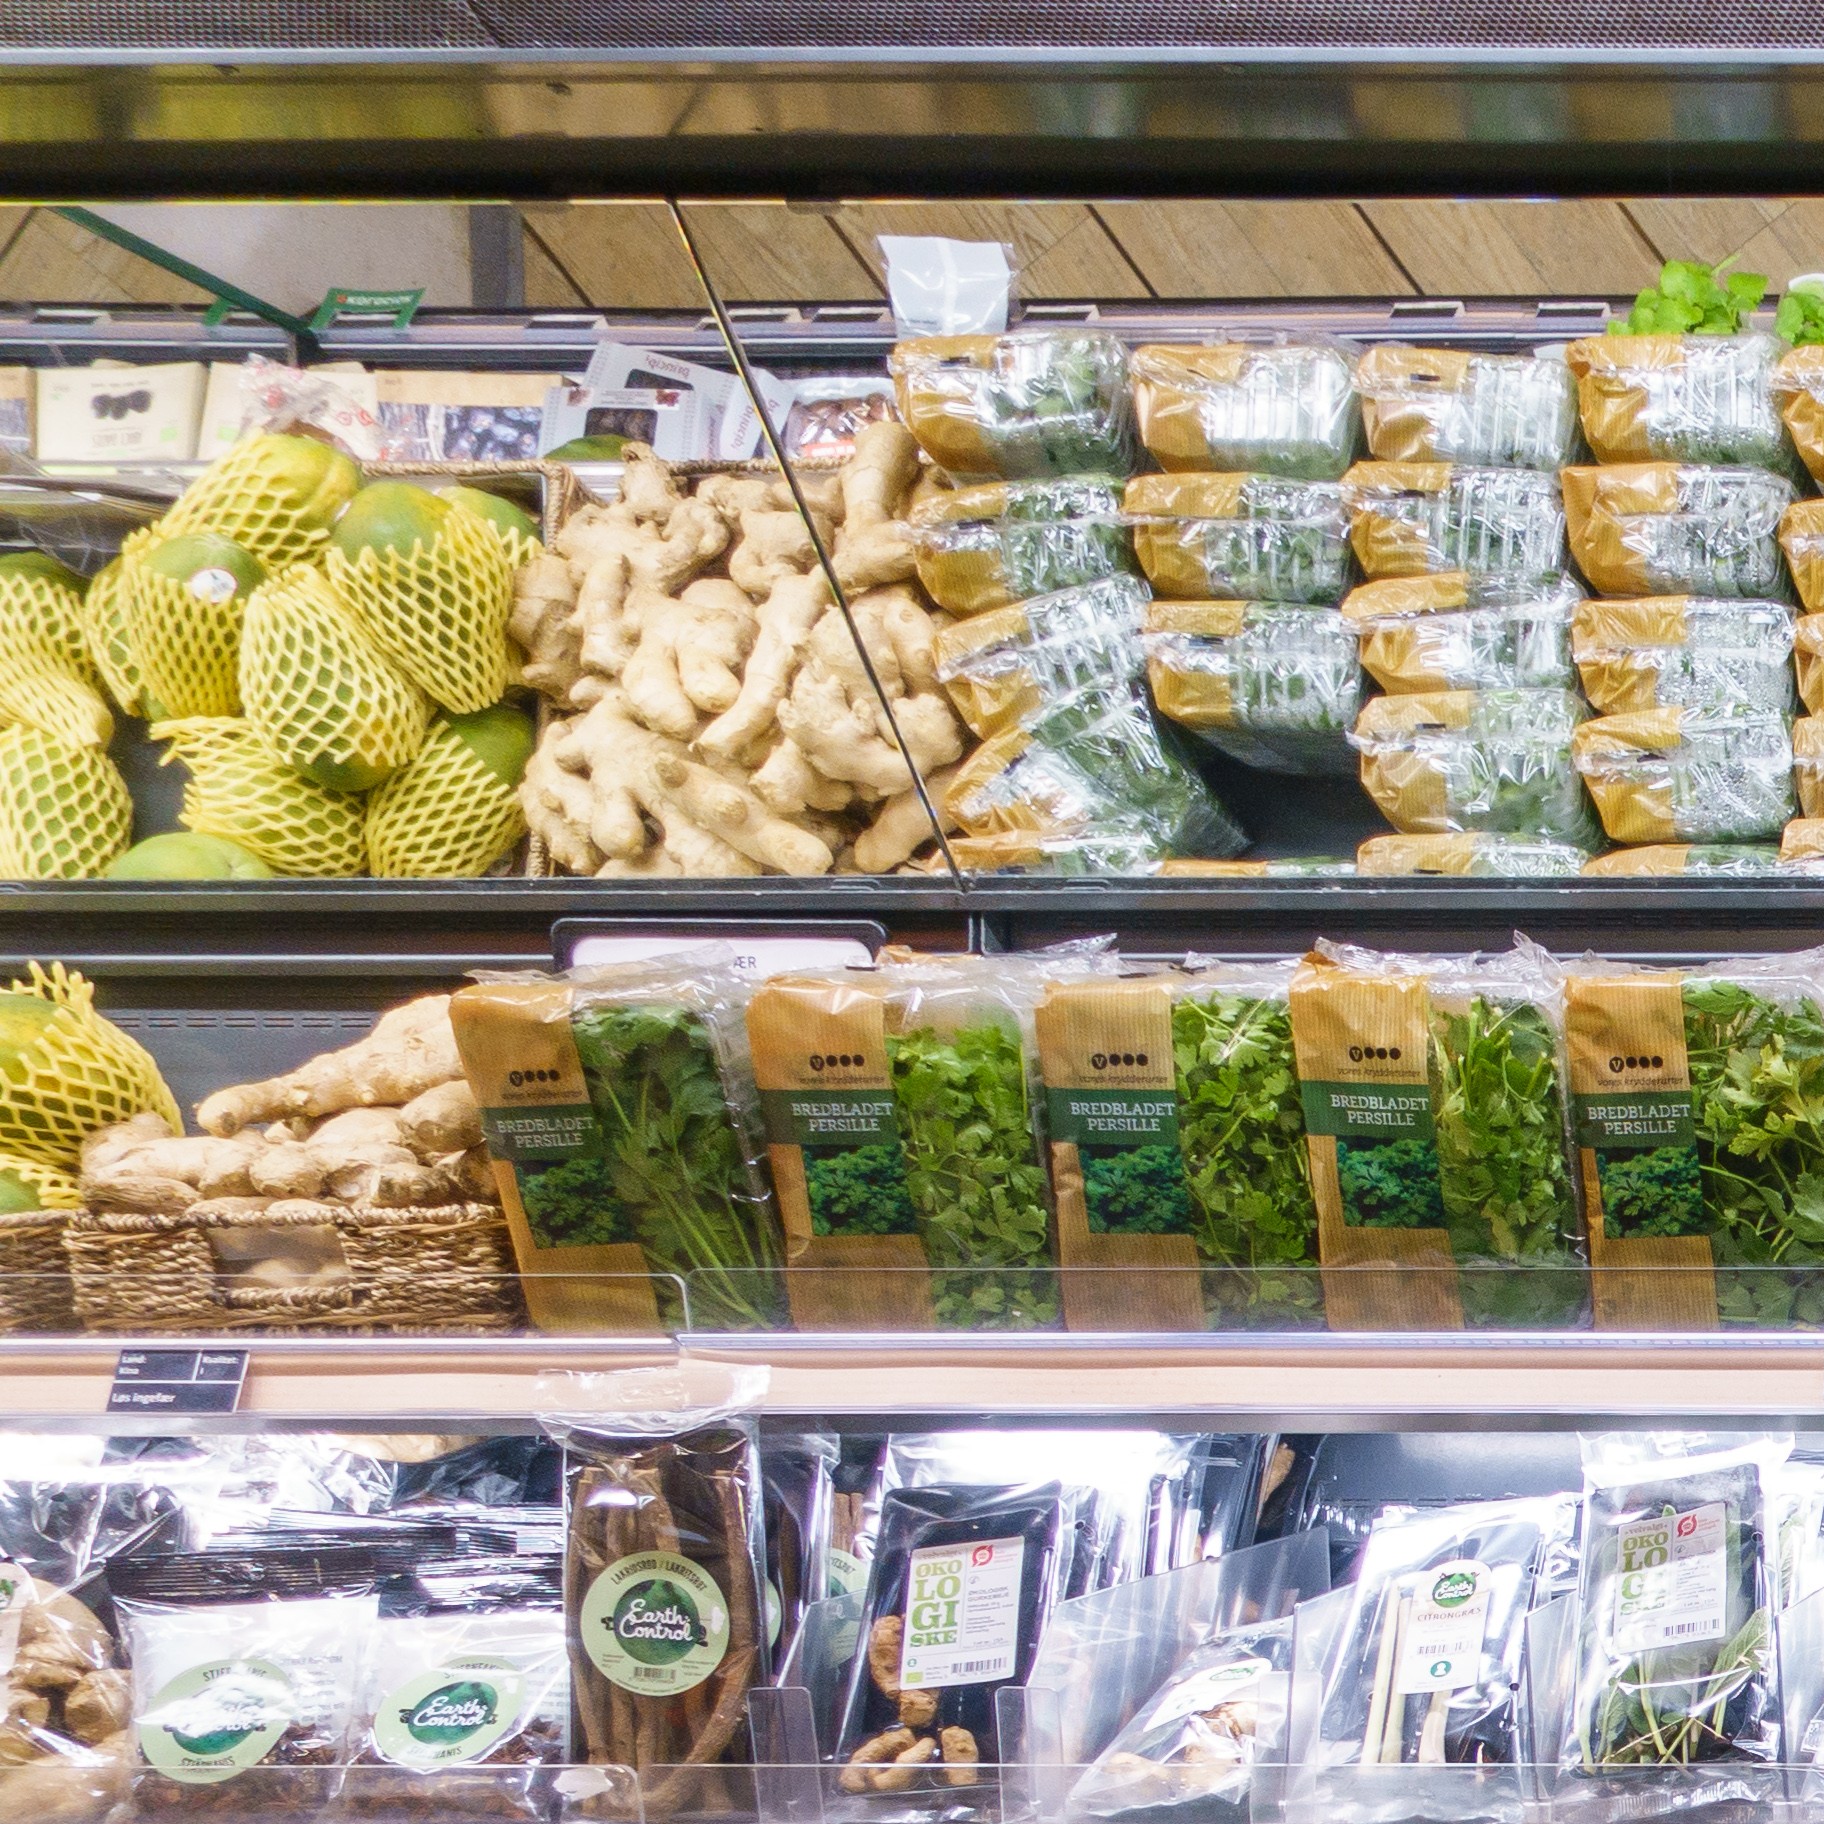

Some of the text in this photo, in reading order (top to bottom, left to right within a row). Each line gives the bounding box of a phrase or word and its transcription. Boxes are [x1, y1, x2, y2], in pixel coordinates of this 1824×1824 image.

[792, 1103, 893, 1118] BREDBLADET
[1331, 1094, 1429, 1112] BREDBLADET
[1347, 1111, 1416, 1127] PERSILLE
[1587, 1104, 1690, 1121] BREDBLADET
[809, 1117, 880, 1133] PERSILLE
[1604, 1119, 1677, 1136] PERSILLE
[112, 1392, 133, 1404] Løs
[627, 1598, 686, 1627] Earth
[619, 1618, 693, 1643] Control
